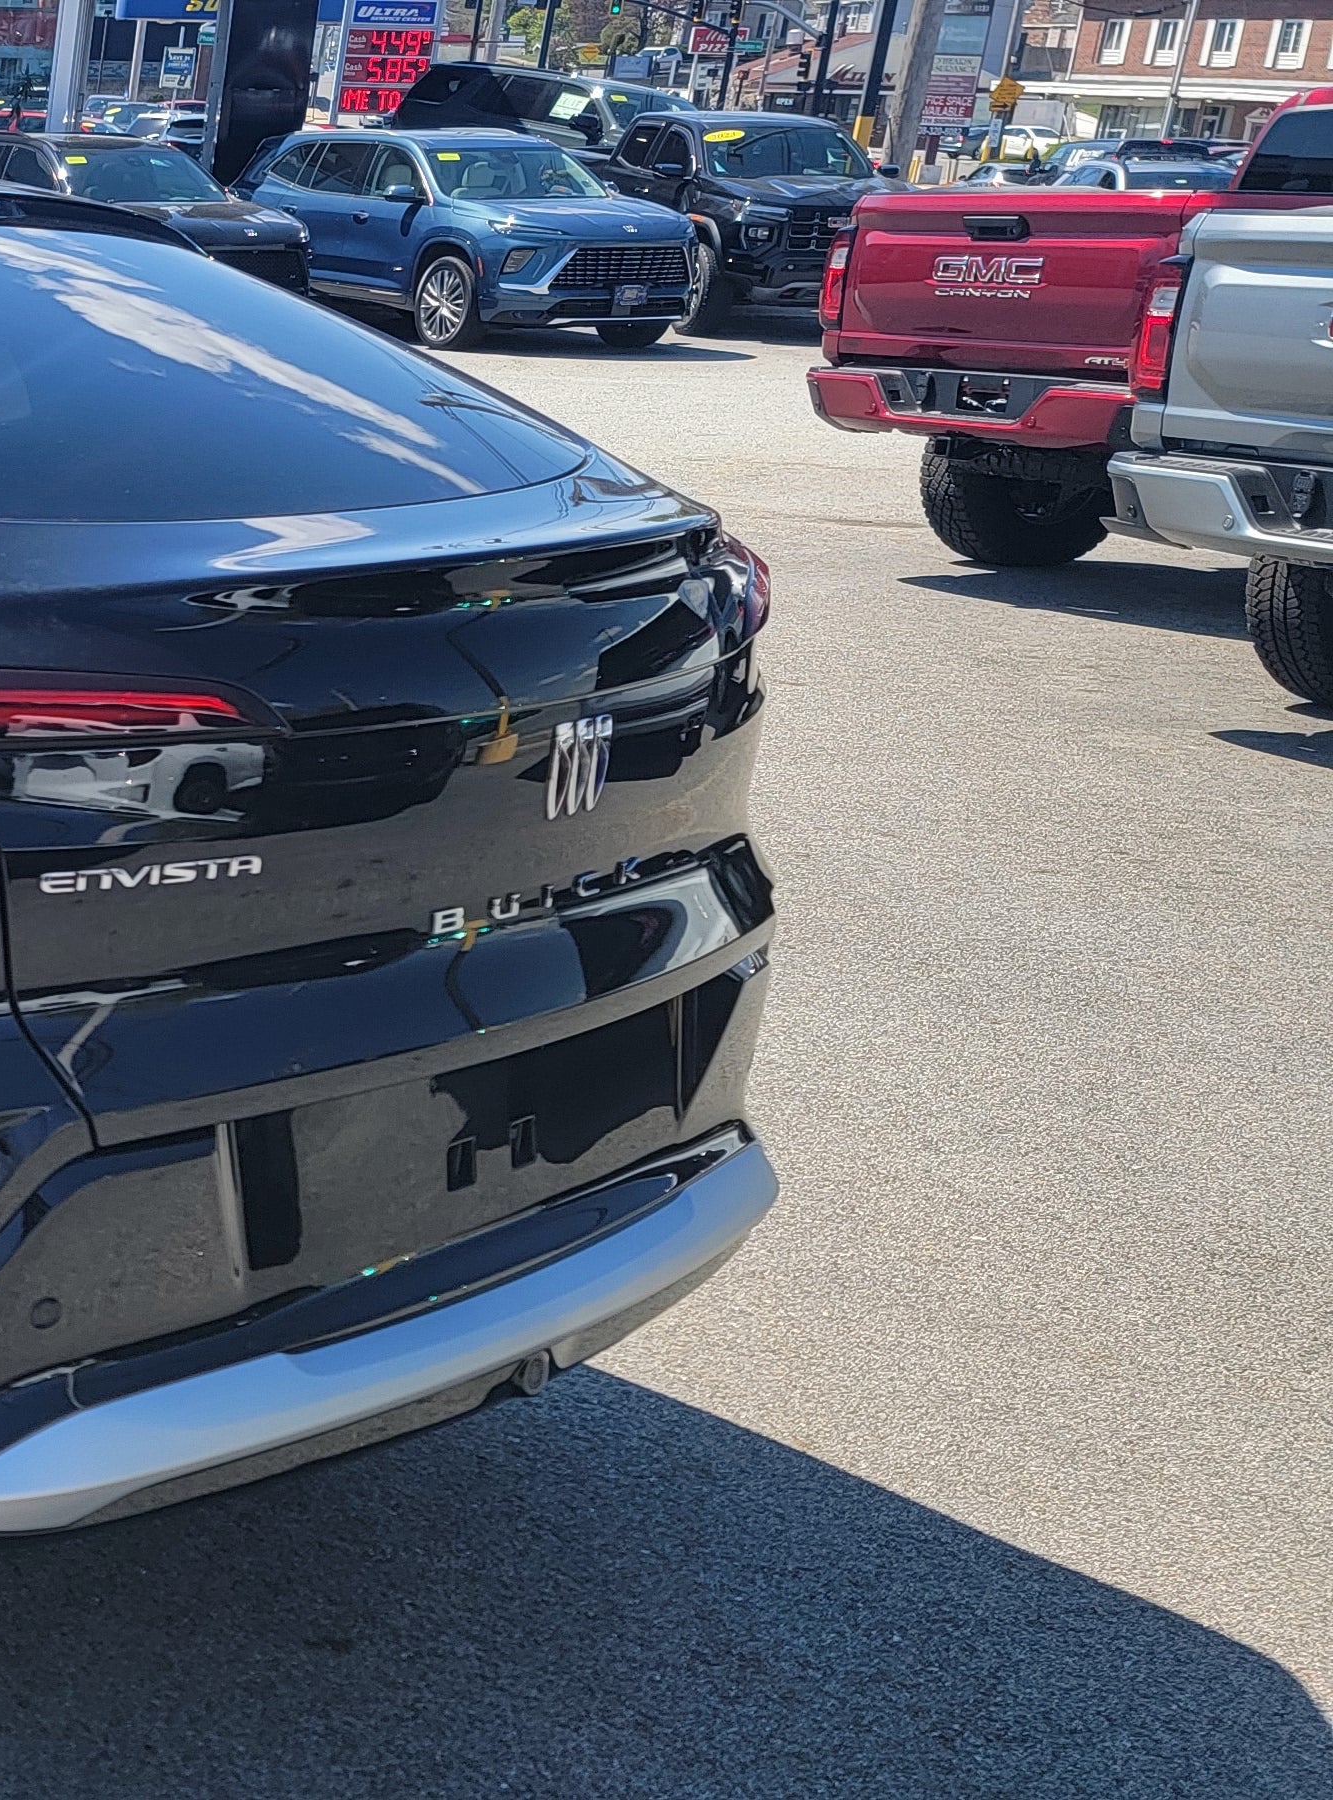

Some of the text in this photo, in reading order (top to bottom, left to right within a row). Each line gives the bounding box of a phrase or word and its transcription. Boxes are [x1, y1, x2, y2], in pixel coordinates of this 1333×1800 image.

[357, 6, 420, 18] ULTRA
[349, 35, 367, 43] Cash
[698, 43, 729, 52] PIZZ
[344, 62, 363, 71] Cash
[932, 255, 1044, 284] GMC
[934, 288, 1031, 299] CANYON
[39, 855, 263, 894] ENVISTA
[433, 857, 642, 936] BUICK
